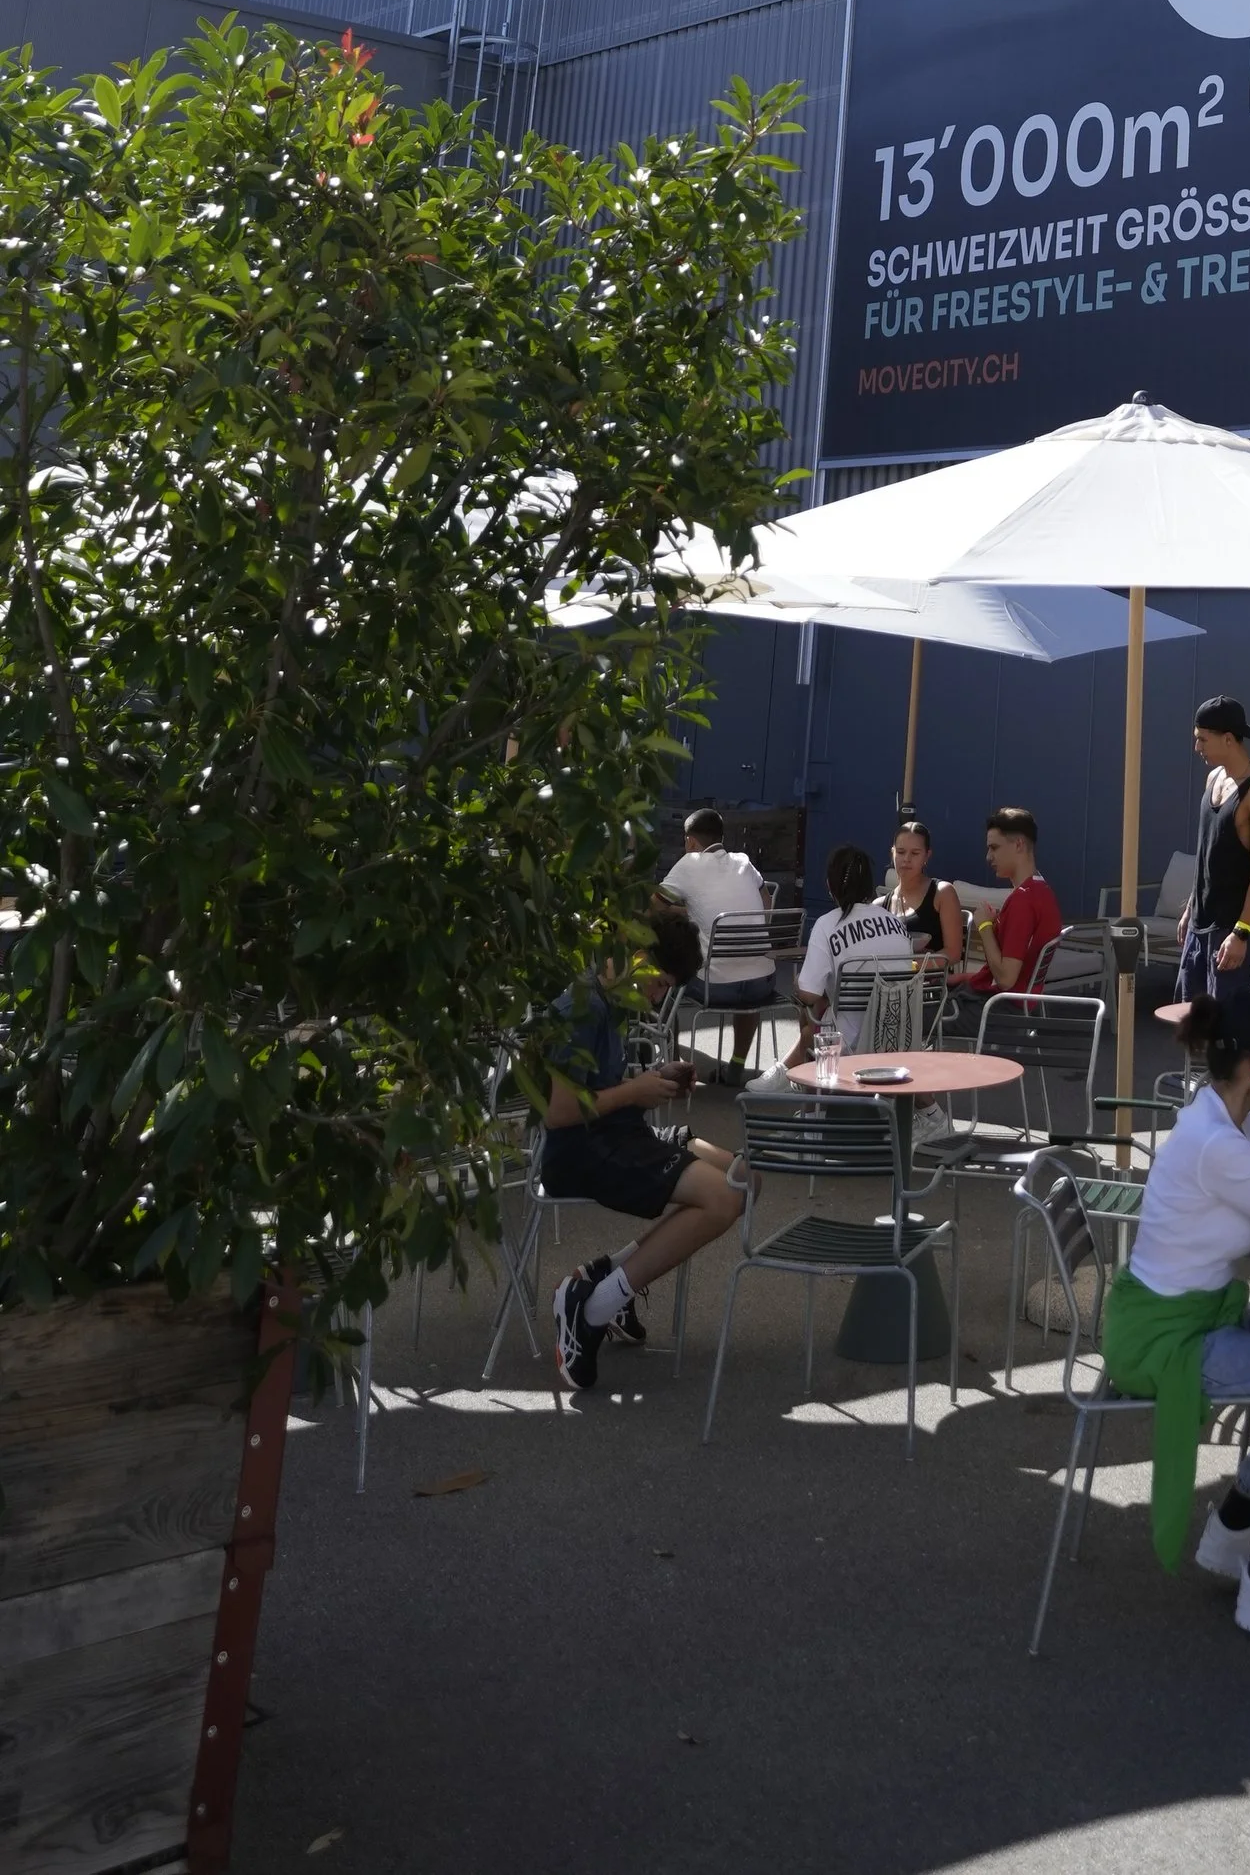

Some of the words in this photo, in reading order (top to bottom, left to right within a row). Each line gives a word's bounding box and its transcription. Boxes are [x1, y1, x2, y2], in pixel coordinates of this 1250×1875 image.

[867, 213, 1108, 287] SCHWEIZWEIT
[864, 289, 924, 339] FÜR
[931, 269, 1132, 331] FREESTYLE-
[1140, 262, 1168, 305] &
[858, 352, 1020, 395] MOVECITY.CH
